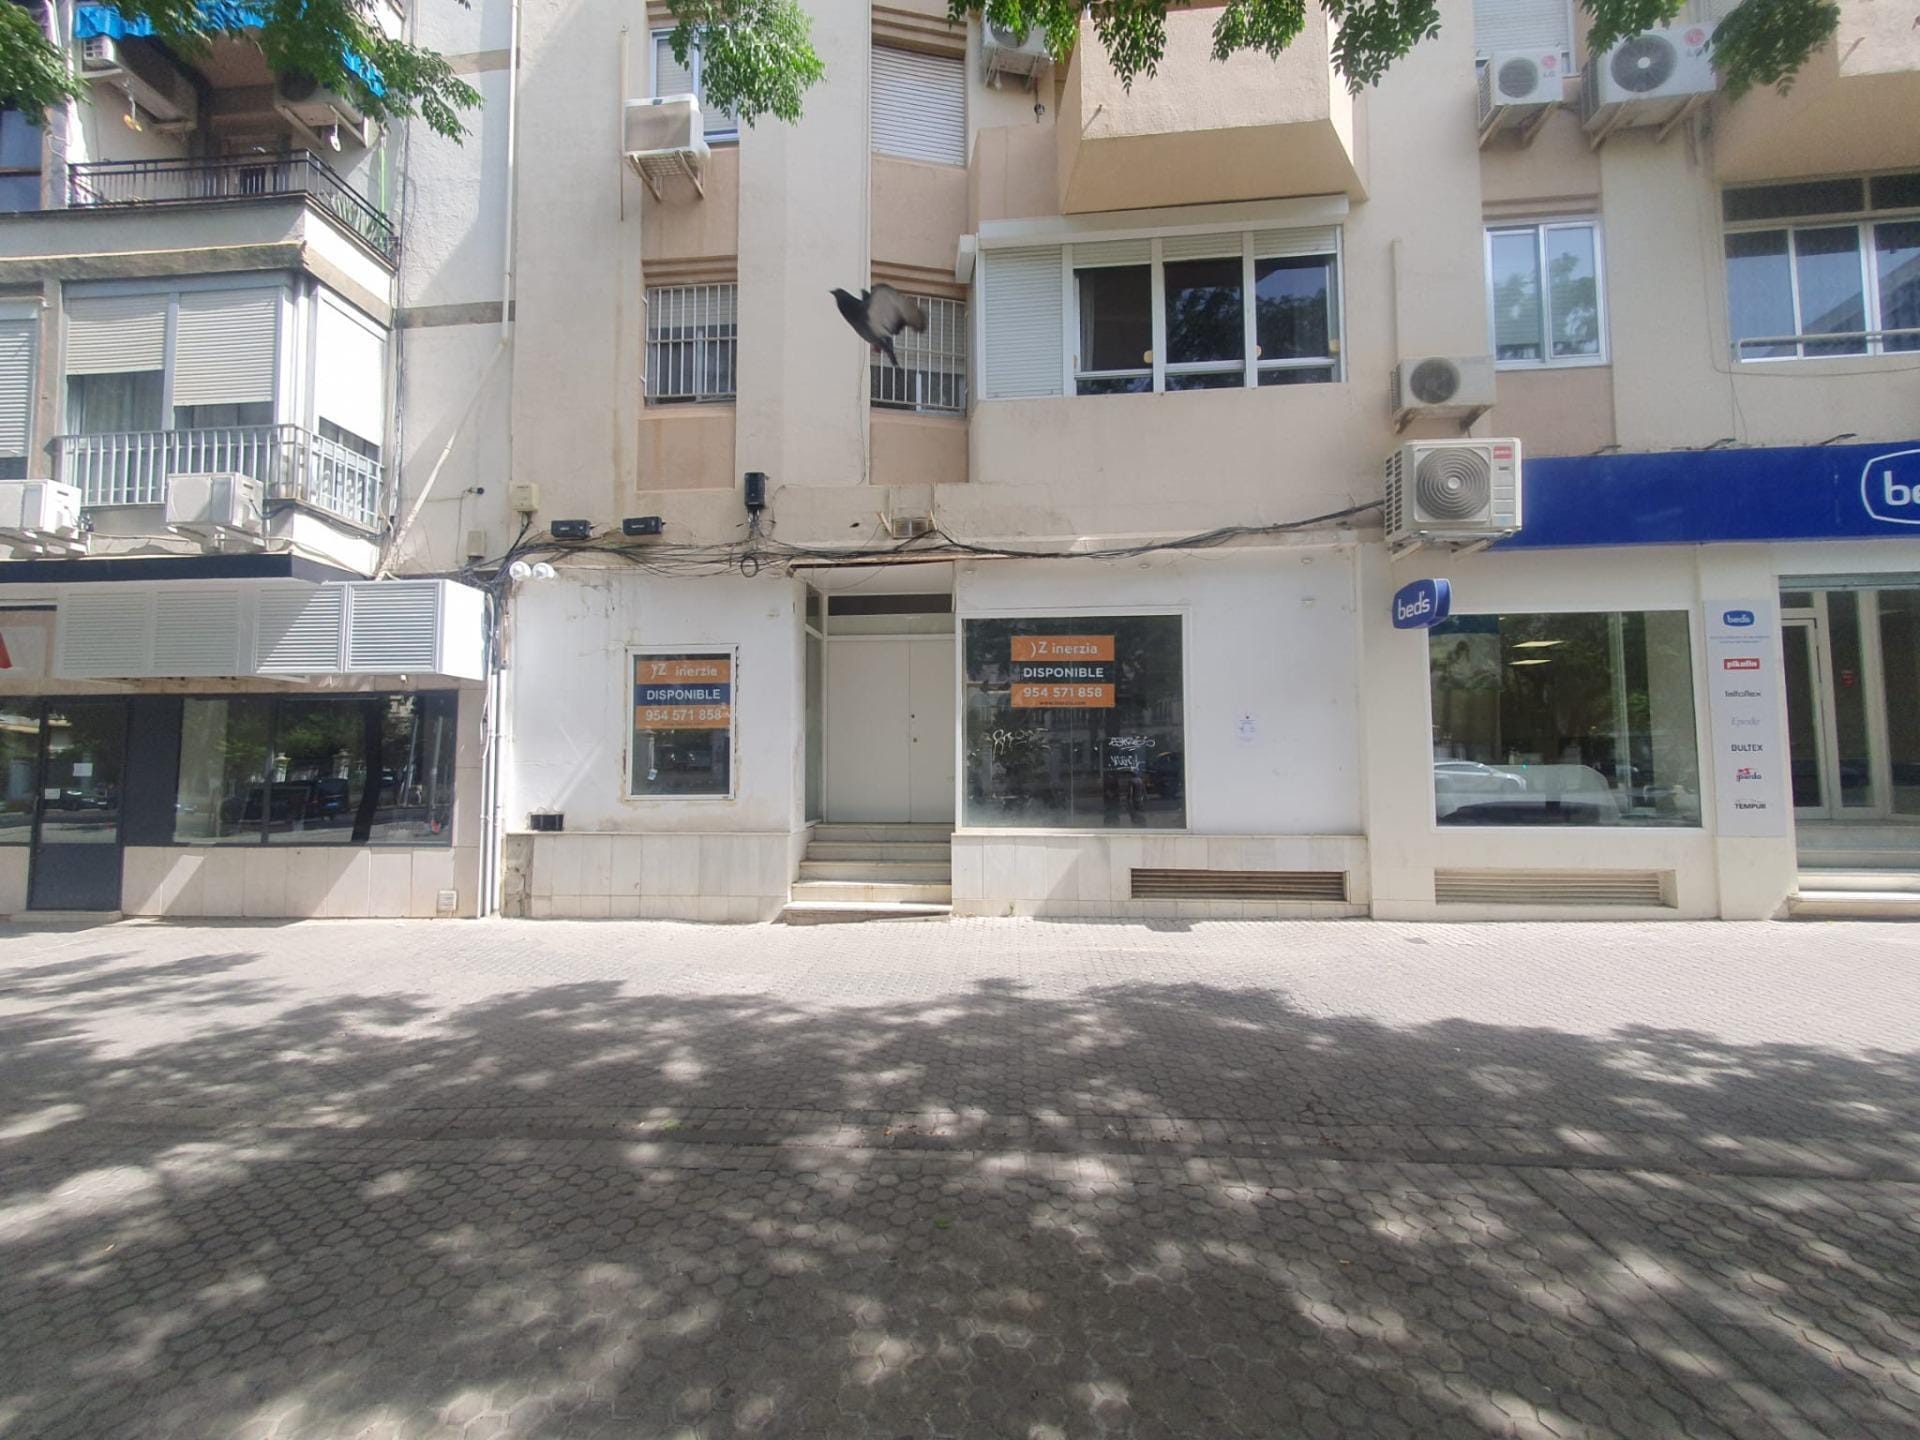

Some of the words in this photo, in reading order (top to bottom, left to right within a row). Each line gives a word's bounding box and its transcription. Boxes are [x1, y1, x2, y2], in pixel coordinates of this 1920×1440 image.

[1052, 643, 1097, 654] inerzia
[1023, 668, 1104, 678] DISPONIBLE
[647, 689, 720, 700] DISPONIBLE
[1023, 688, 1048, 698] 954
[1053, 688, 1074, 698] 571
[1078, 688, 1103, 698] 858
[646, 710, 668, 721] 954
[673, 710, 694, 721] 571
[699, 709, 721, 720] 858
